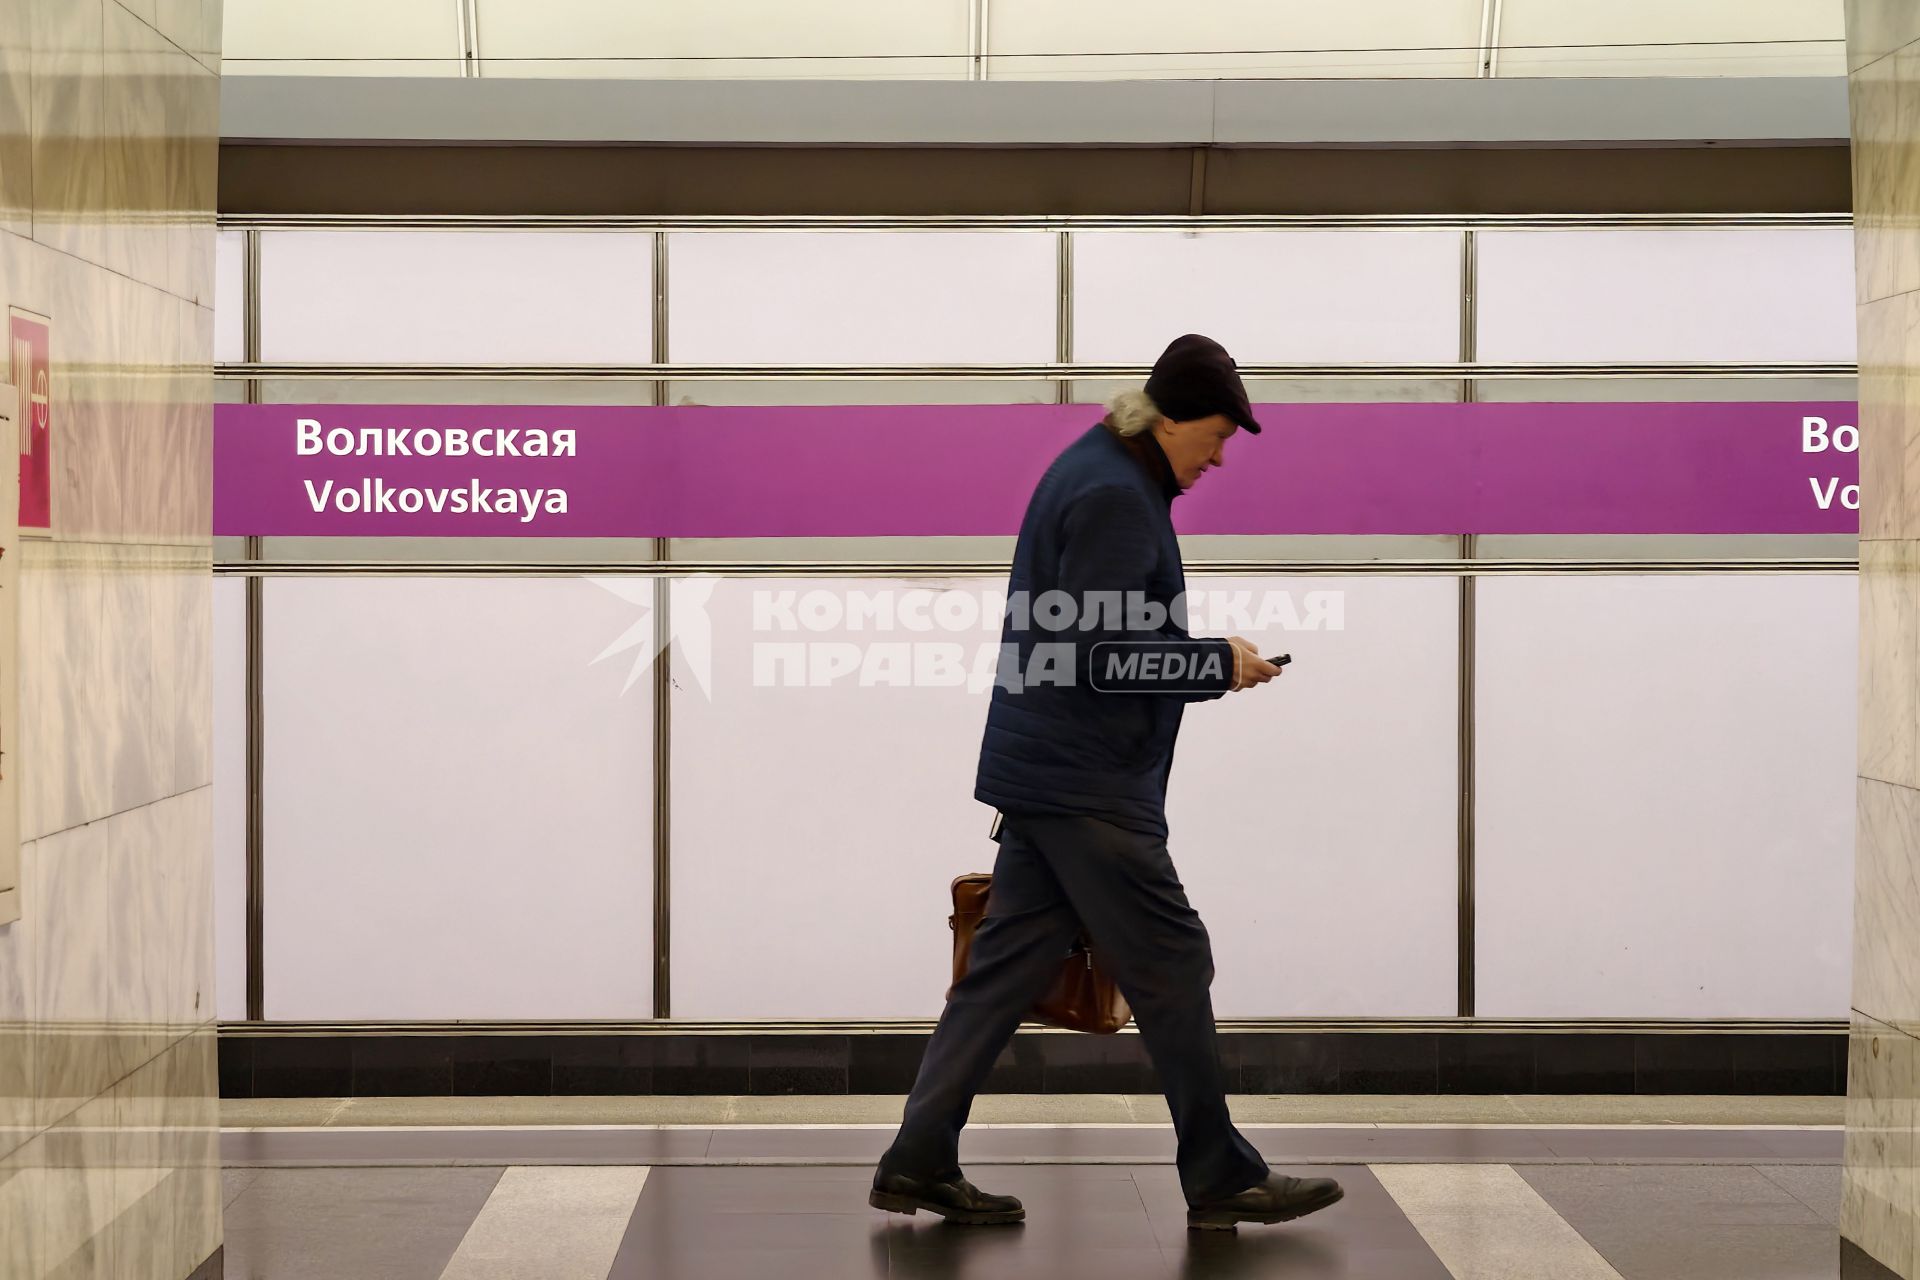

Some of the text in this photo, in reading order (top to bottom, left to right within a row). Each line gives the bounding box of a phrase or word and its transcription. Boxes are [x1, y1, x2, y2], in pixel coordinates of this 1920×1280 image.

[296, 418, 577, 457] Волковская
[1802, 416, 1859, 453] Во
[303, 478, 568, 522] Volkovskaya
